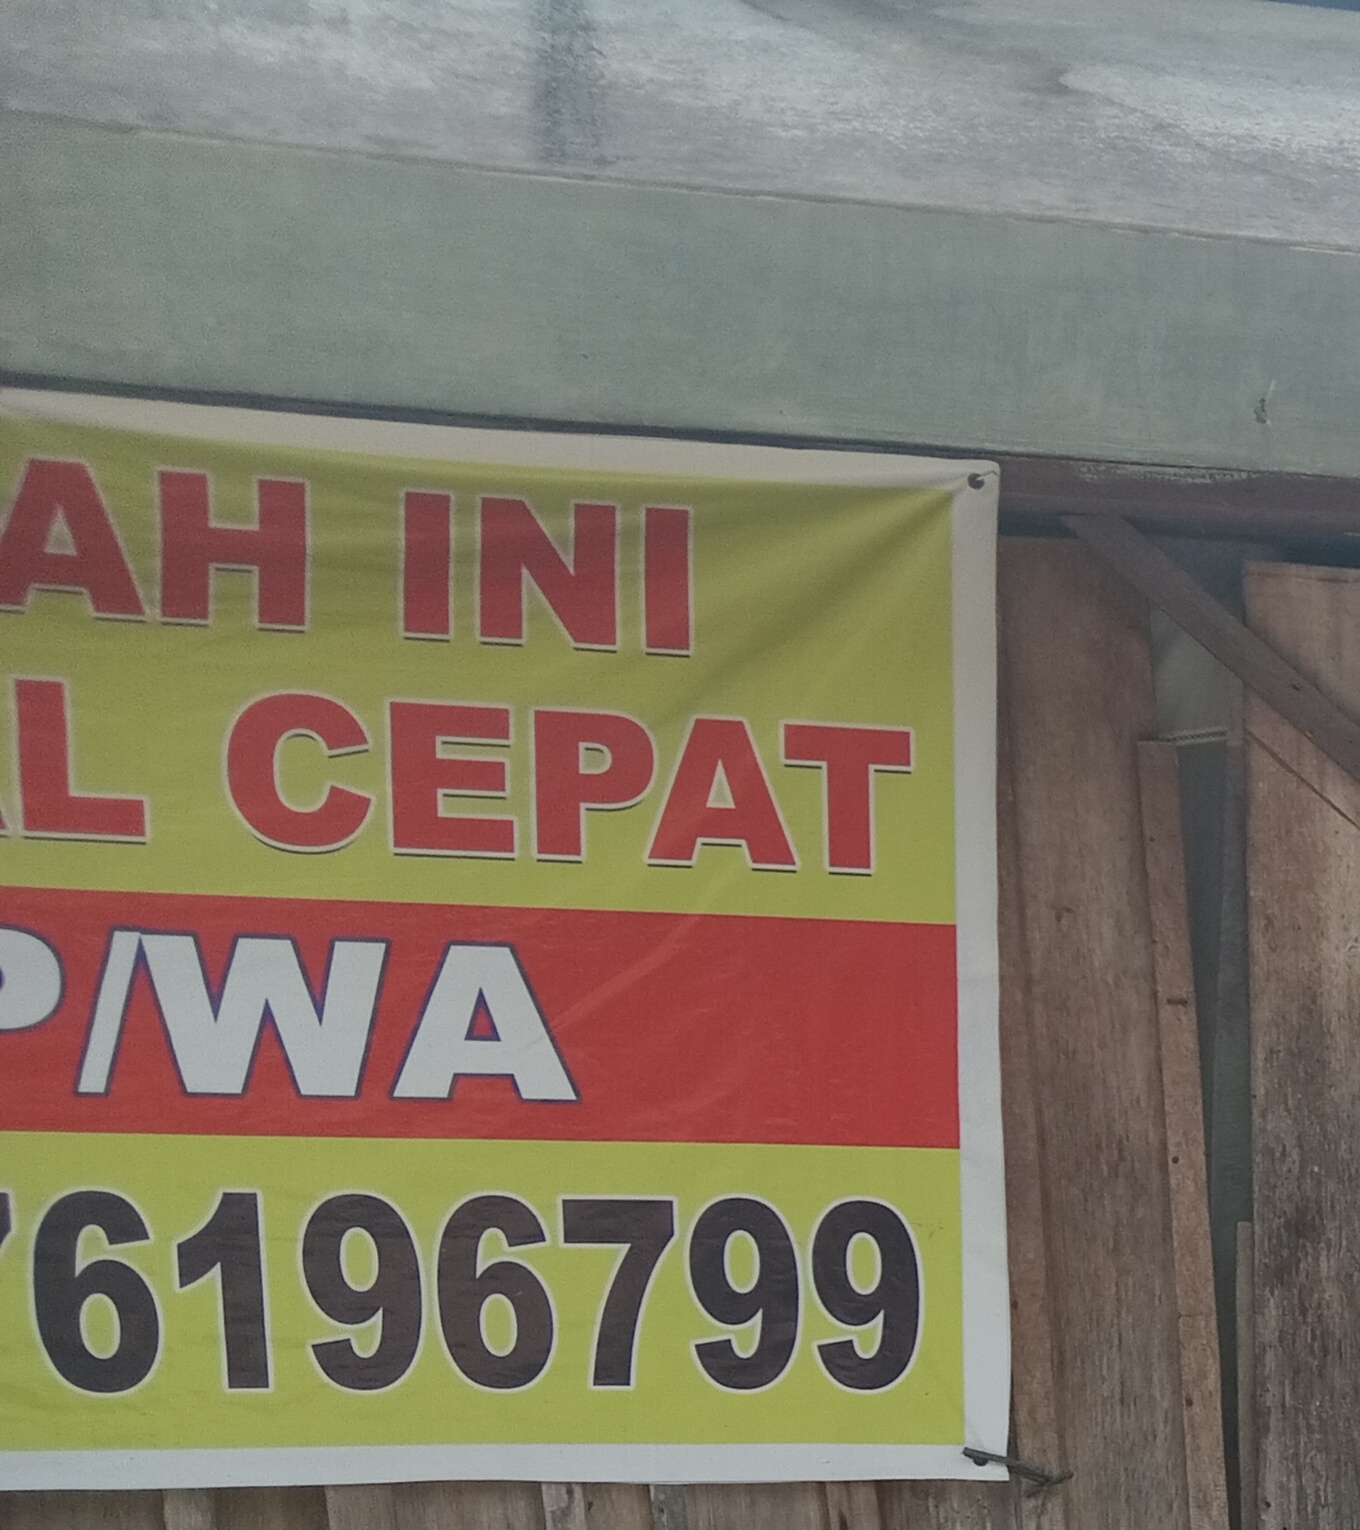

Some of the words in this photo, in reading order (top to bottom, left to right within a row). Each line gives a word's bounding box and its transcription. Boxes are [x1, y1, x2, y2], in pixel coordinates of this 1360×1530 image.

[0, 457, 309, 632] AH
[402, 489, 693, 657] INI
[0, 676, 149, 844] L
[225, 690, 914, 877] CEPAT
[0, 1187, 922, 1394] 6196799
